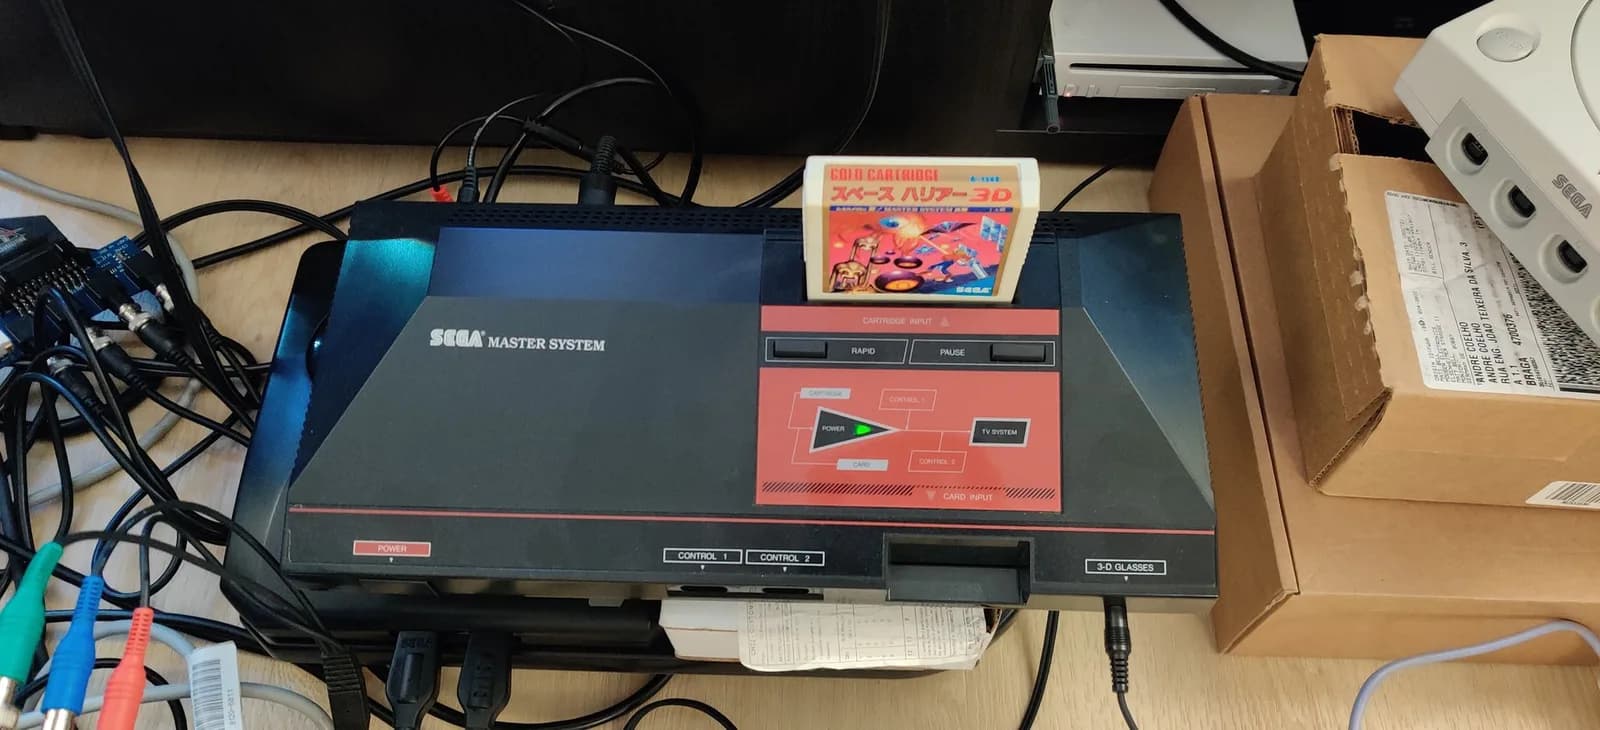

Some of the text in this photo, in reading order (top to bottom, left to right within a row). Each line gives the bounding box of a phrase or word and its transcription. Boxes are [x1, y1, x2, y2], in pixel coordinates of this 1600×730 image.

[830, 168, 939, 182] GOLD CARTRIDGE
[831, 186, 1013, 202] スペース ハリアー 3D
[1551, 174, 1593, 220] SEGA
[1471, 287, 1489, 320] TEIXEIRA
[862, 316, 933, 326] CARTRIDGE INPUT
[1502, 313, 1523, 346] 4700376
[429, 328, 606, 352] SEGA MASTER SYSTEM
[1459, 321, 1476, 352] COELHO
[851, 347, 876, 355] RAPID
[940, 348, 966, 357] PAUSE
[1470, 322, 1498, 384] ANDRE COELHO
[1497, 367, 1510, 385] RUA
[1518, 357, 1537, 386] BRAGA
[821, 425, 846, 433] POWER
[981, 428, 1018, 437] TV SYSTEM
[943, 492, 994, 502] CARD INPUT
[377, 544, 408, 553] POWER
[678, 551, 718, 561] CONTROL
[760, 553, 811, 563] CONTROL 2
[1096, 562, 1155, 572] 3-D GLASSES
